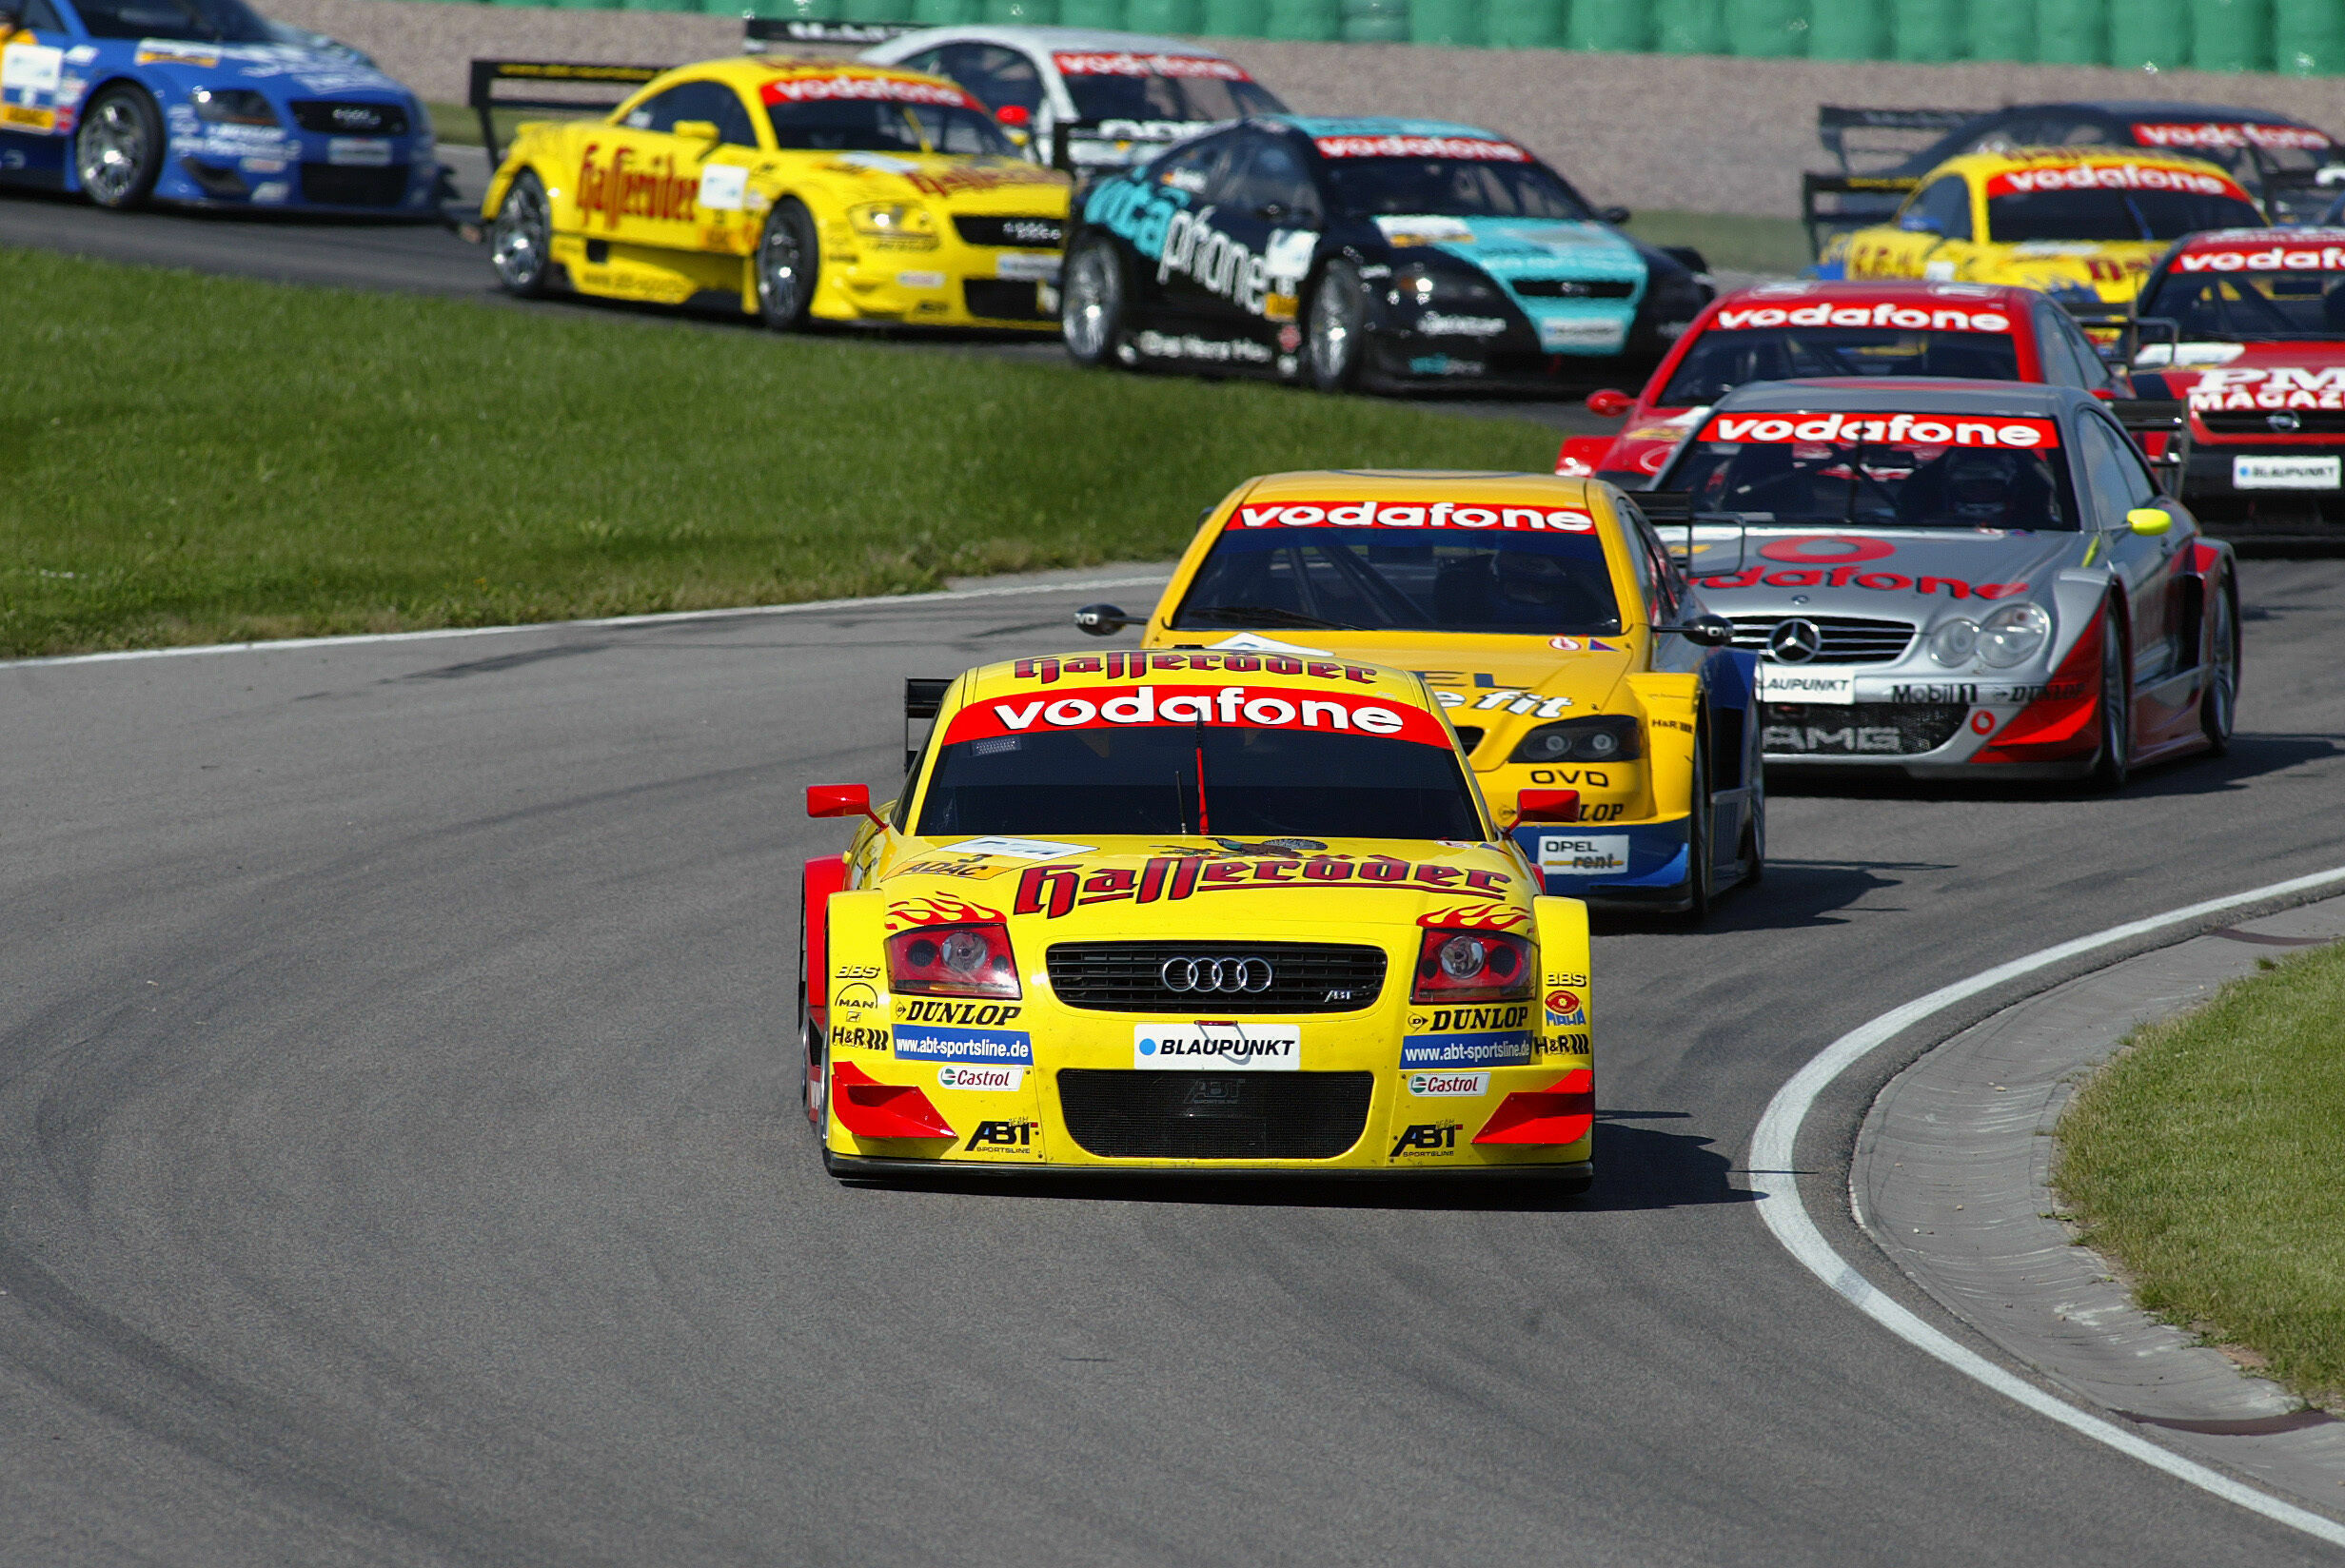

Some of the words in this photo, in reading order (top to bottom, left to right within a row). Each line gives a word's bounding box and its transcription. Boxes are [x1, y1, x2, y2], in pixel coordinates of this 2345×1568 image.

[2004, 163, 2225, 194] vodafone
[2180, 246, 2345, 272] vodaf
[1718, 303, 2010, 331] vodafone
[2189, 388, 2345, 409] MAGAZ
[1716, 413, 2043, 448] vodafone
[1240, 501, 1594, 533] vodafone
[1688, 564, 2029, 600] dafone
[1757, 676, 1850, 692] LAUPUNKT
[2007, 680, 2087, 702] DUNLOP
[994, 686, 1404, 735] vodafone
[1470, 691, 1573, 718] fit
[1762, 726, 1902, 751] AMG
[1578, 803, 1625, 822] LOP
[1545, 841, 1599, 853] OPEL
[1571, 853, 1615, 870] rent
[835, 965, 880, 979] BBS
[1544, 971, 1587, 988] BBS
[838, 998, 875, 1009] MAN
[906, 1000, 1022, 1026] DUNLOP
[1429, 1006, 1528, 1032] DUNLOP
[896, 1036, 1029, 1058] www.abt-sportsline.de
[1159, 1039, 1295, 1056] BLAUPUNKT
[1405, 1040, 1530, 1063] www.abt-sportsline.de
[956, 1069, 1010, 1087] Castrol
[1427, 1075, 1479, 1092] Castrol
[964, 1121, 1031, 1151] ABT
[1389, 1125, 1455, 1157] ABT
